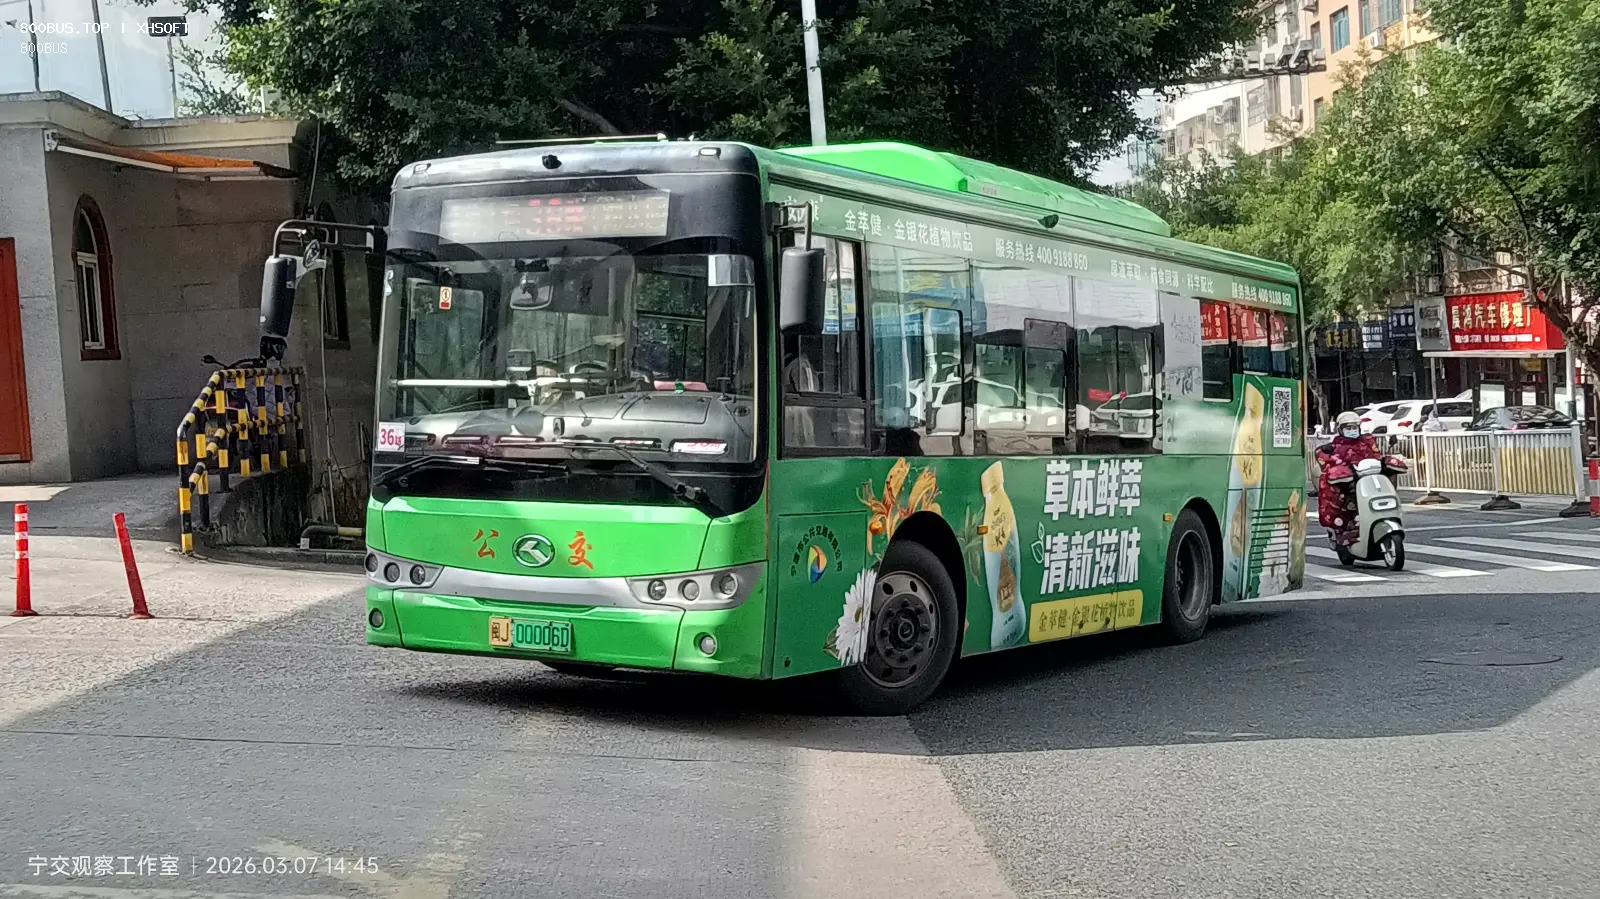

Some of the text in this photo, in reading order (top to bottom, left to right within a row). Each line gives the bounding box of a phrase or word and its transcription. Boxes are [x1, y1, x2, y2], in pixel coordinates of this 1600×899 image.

[995, 237, 1089, 271] 服务热线 400 9188 860
[1043, 458, 1143, 521] 草本鲜萃
[473, 528, 594, 570] 公 交
[1040, 526, 1142, 595] 清新滋味
